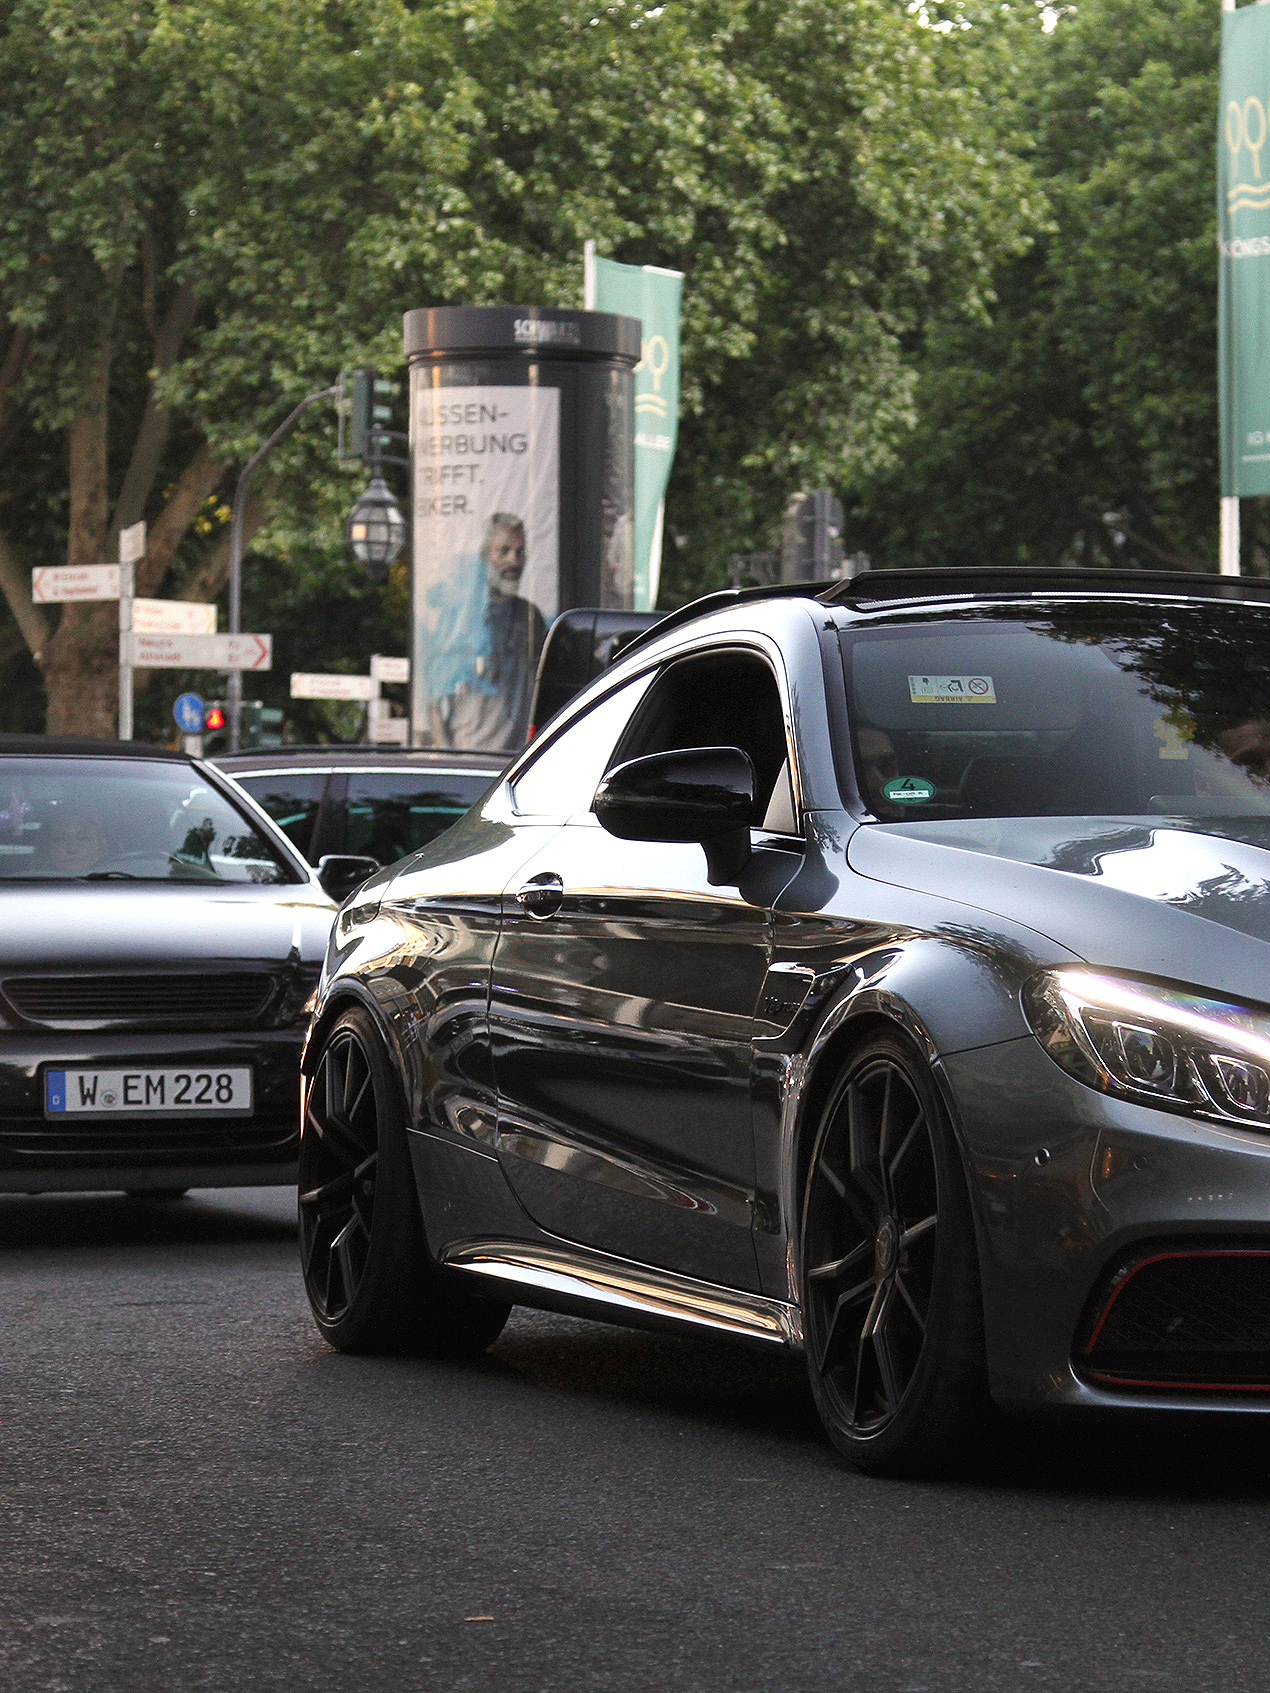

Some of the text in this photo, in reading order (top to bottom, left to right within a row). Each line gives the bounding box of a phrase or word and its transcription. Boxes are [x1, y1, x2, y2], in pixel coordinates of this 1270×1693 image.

[419, 402, 509, 426] USSEN-
[901, 778, 916, 791] 4
[77, 1073, 233, 1106] W EM 228
